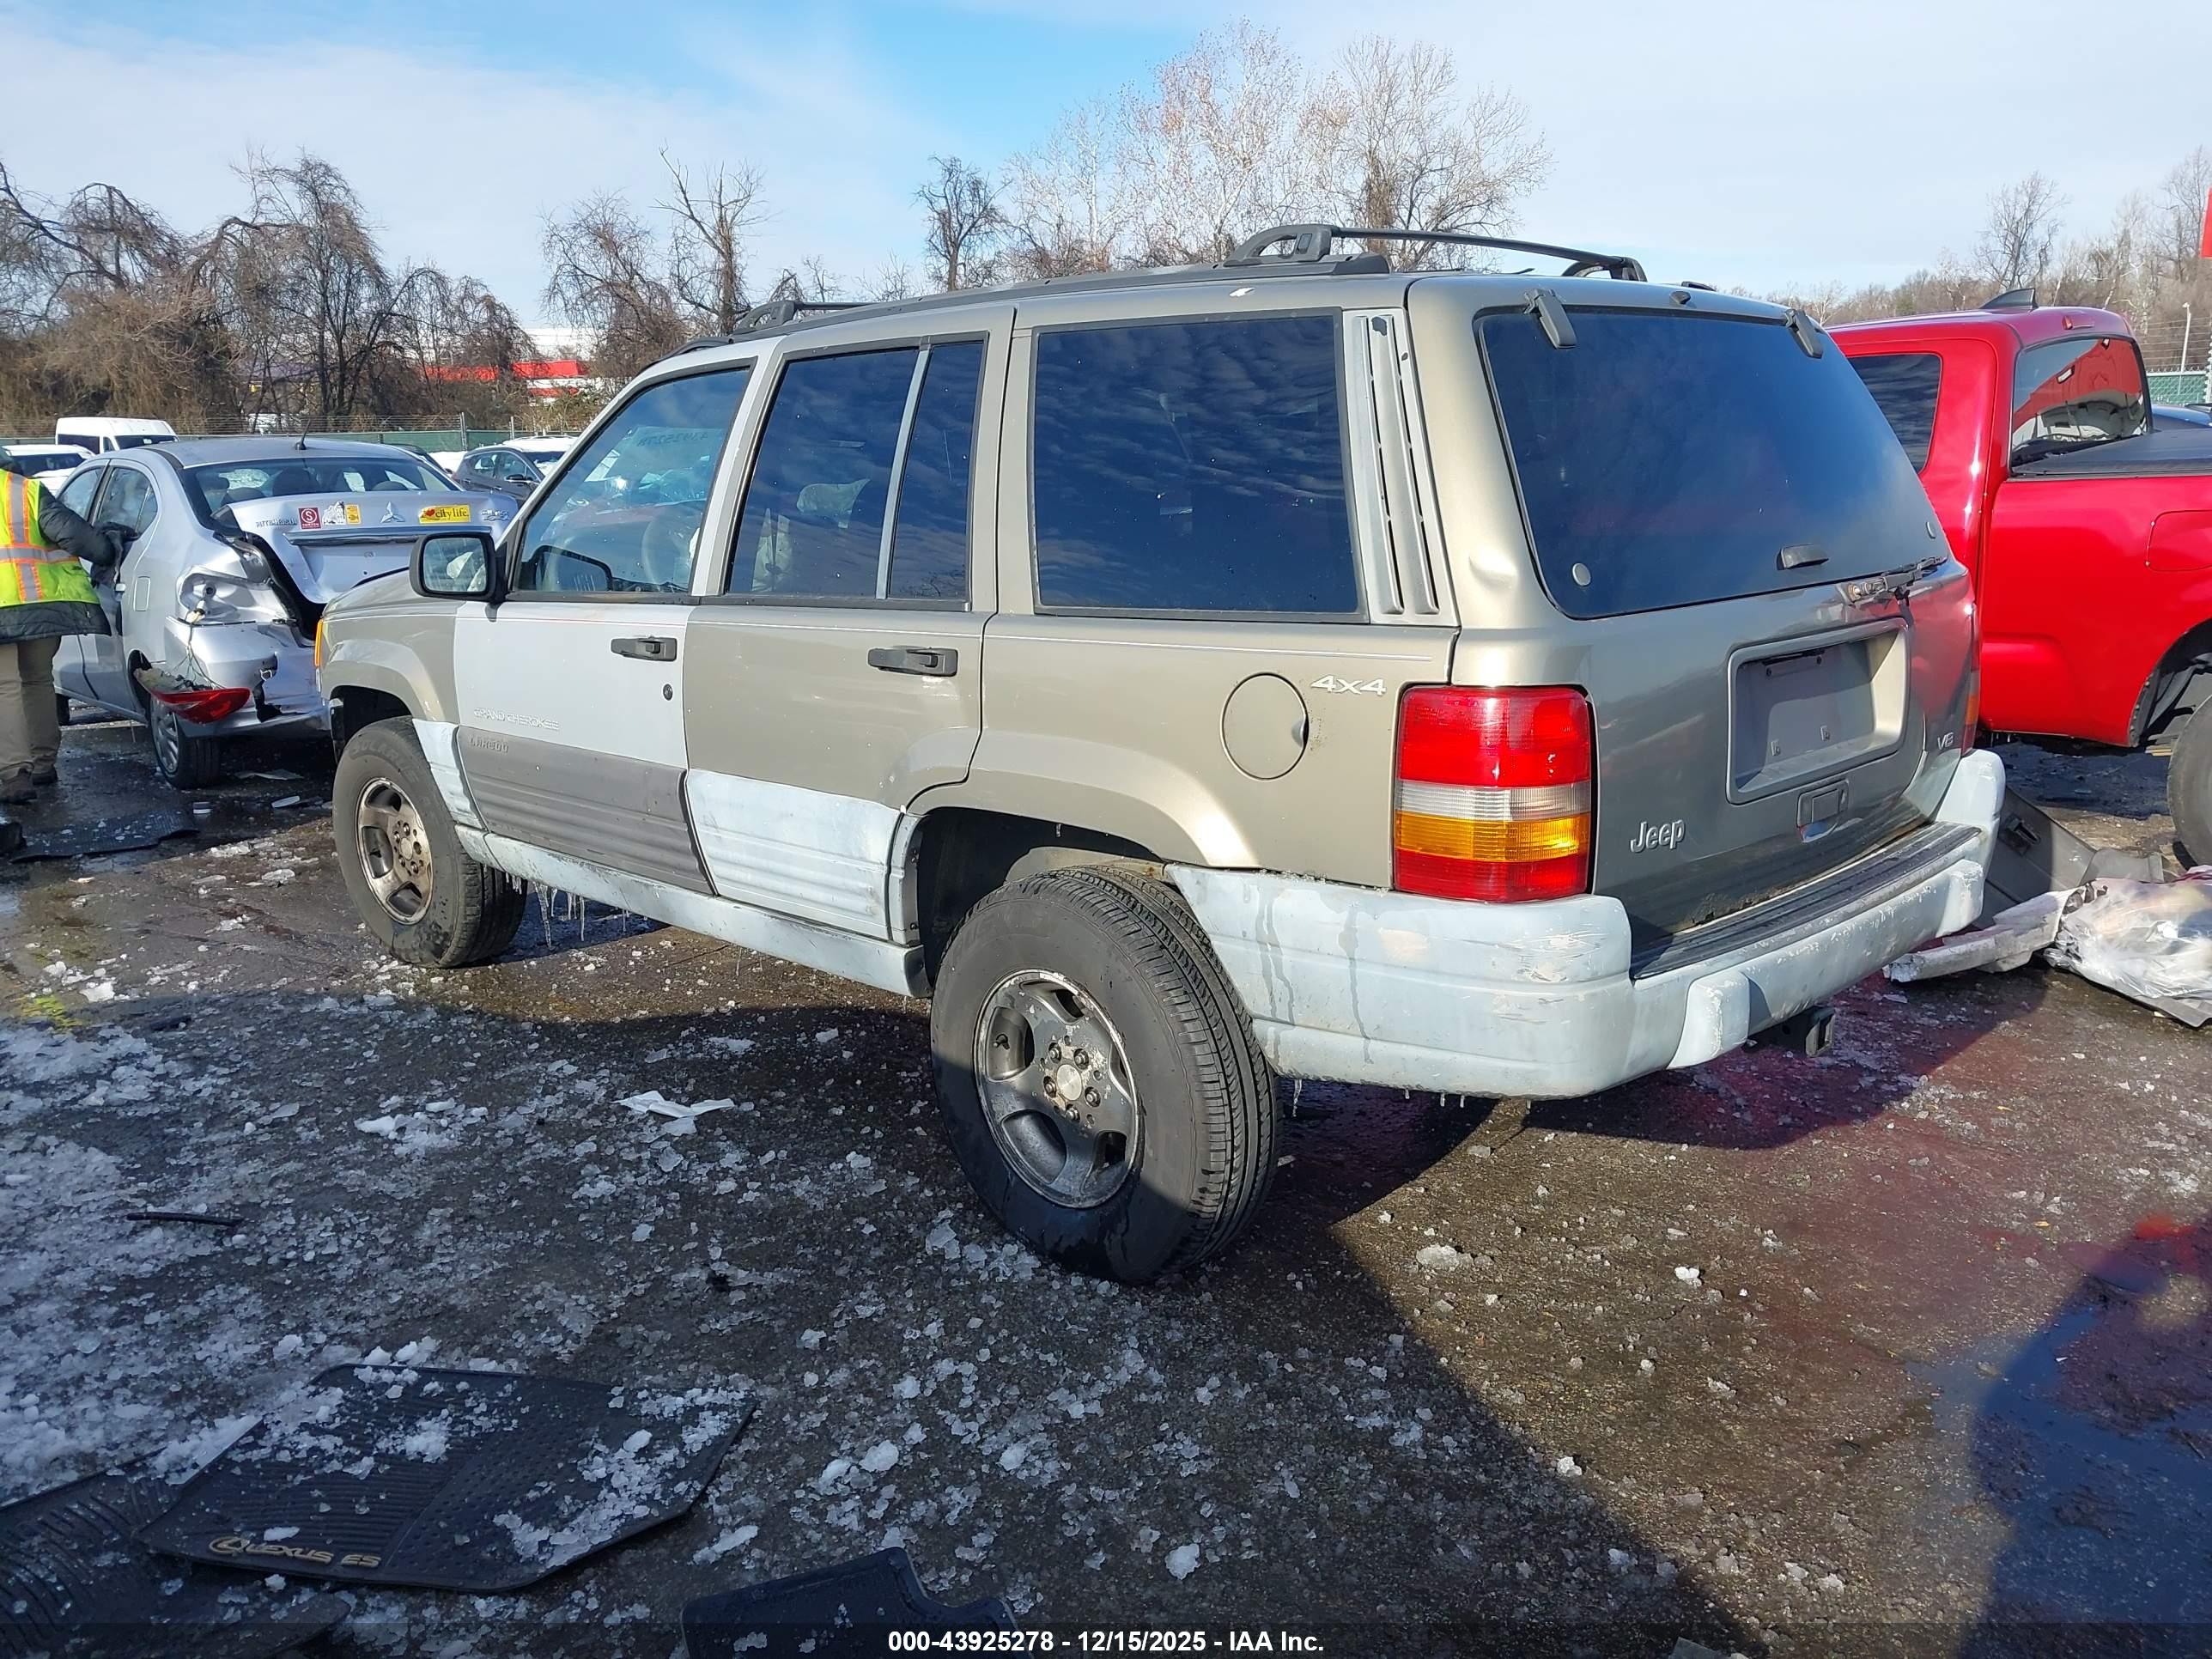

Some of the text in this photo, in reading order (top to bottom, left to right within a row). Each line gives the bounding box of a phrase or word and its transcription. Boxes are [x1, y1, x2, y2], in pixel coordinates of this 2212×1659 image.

[435, 508, 452, 520] city
[474, 708, 560, 732] GRAND CHEROKEE
[1630, 819, 1685, 853] Jeep
[246, 1542, 382, 1567] LEXUS ES
